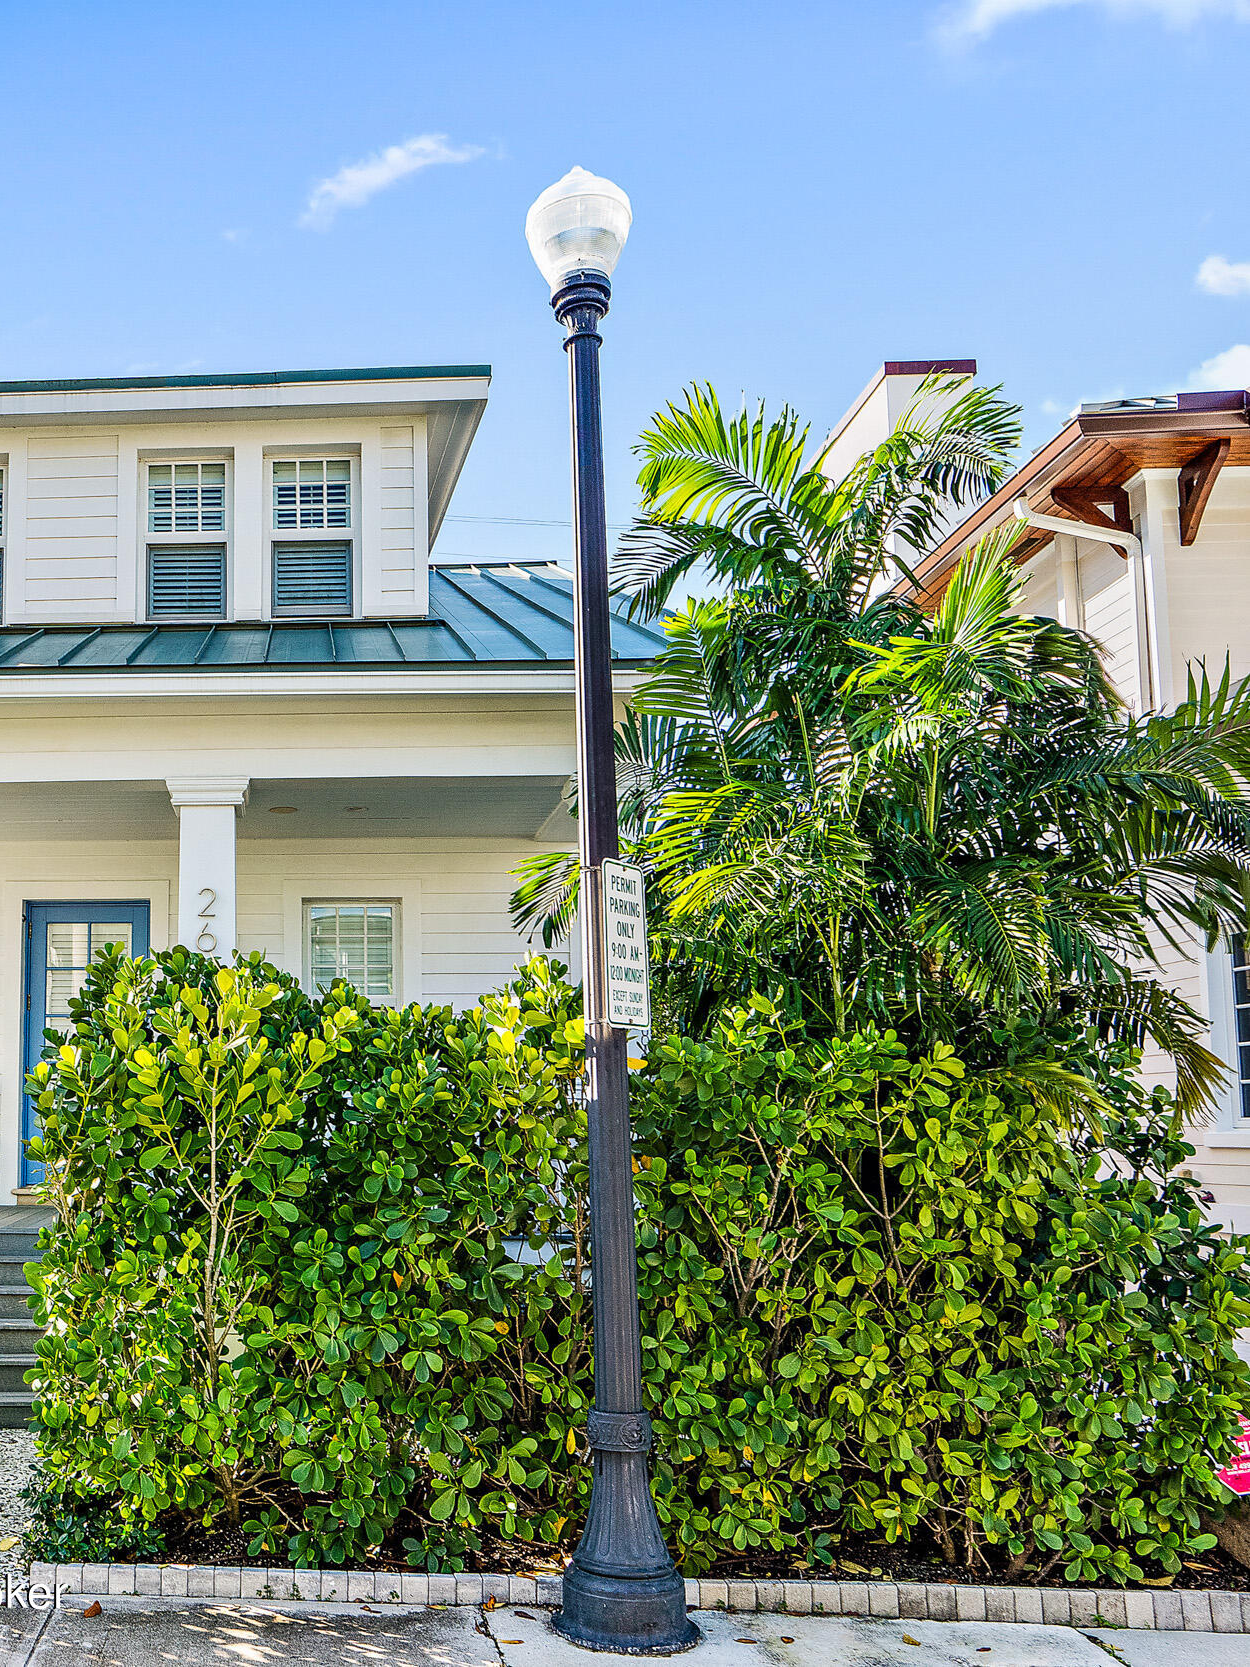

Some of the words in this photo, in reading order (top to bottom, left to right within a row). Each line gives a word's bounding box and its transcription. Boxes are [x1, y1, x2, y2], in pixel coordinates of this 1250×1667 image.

[611, 874, 637, 897] PERMIT
[609, 897, 640, 919] PARKING
[196, 887, 217, 952] 26
[616, 921, 635, 939] ONLY
[611, 942, 627, 960] 9:00
[612, 989, 628, 1002] EXCEPT
[613, 1005, 623, 1016] AND
[624, 1006, 644, 1018] HOLIDAYS
